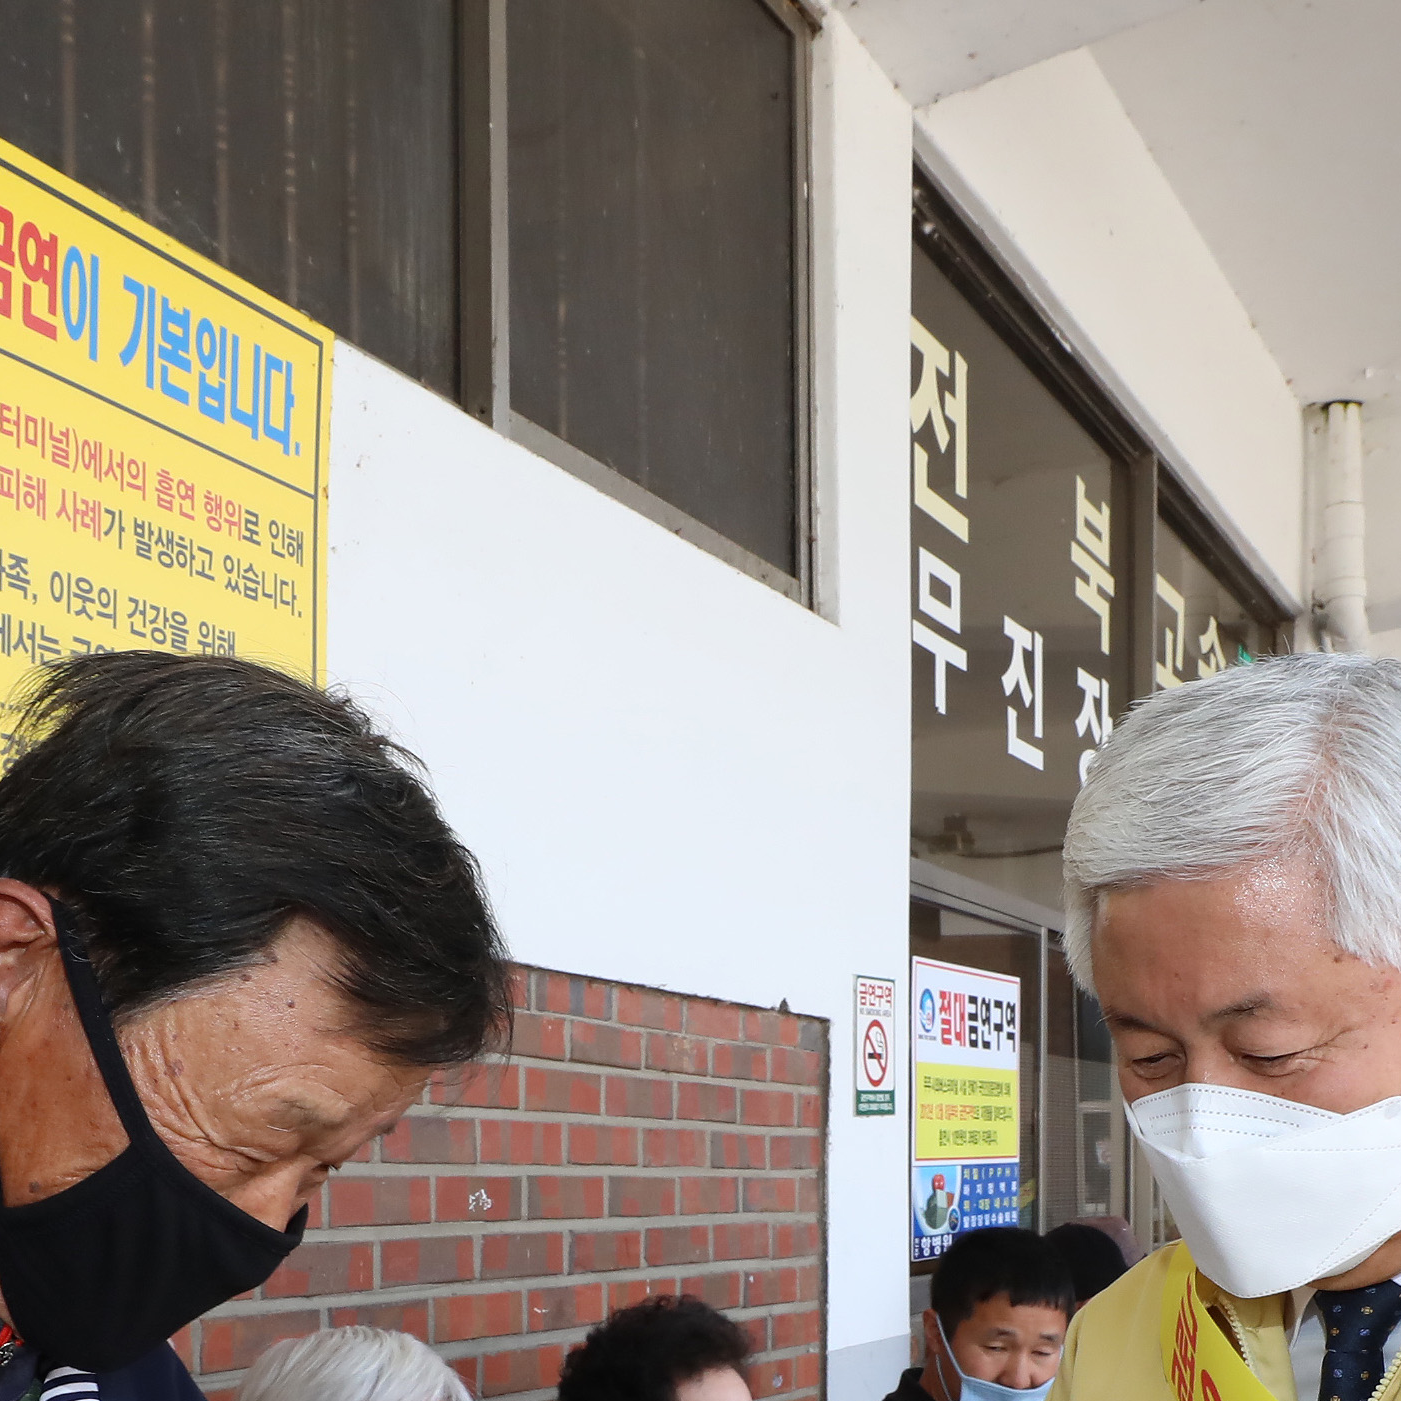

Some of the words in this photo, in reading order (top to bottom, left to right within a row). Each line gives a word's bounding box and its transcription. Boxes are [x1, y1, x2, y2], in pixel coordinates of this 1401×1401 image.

[119, 273, 302, 457] 기본입니다.
[55, 489, 126, 551] 사례가
[132, 506, 216, 583] 발생하고
[223, 557, 303, 619] 있습니다.
[154, 467, 196, 522] 흡연
[202, 489, 261, 547] 행위로
[267, 518, 305, 567] 인해
[49, 569, 118, 630] 이웃의
[127, 600, 190, 653] 건강을
[197, 620, 237, 657] 위해
[859, 982, 892, 1010] 금연구역
